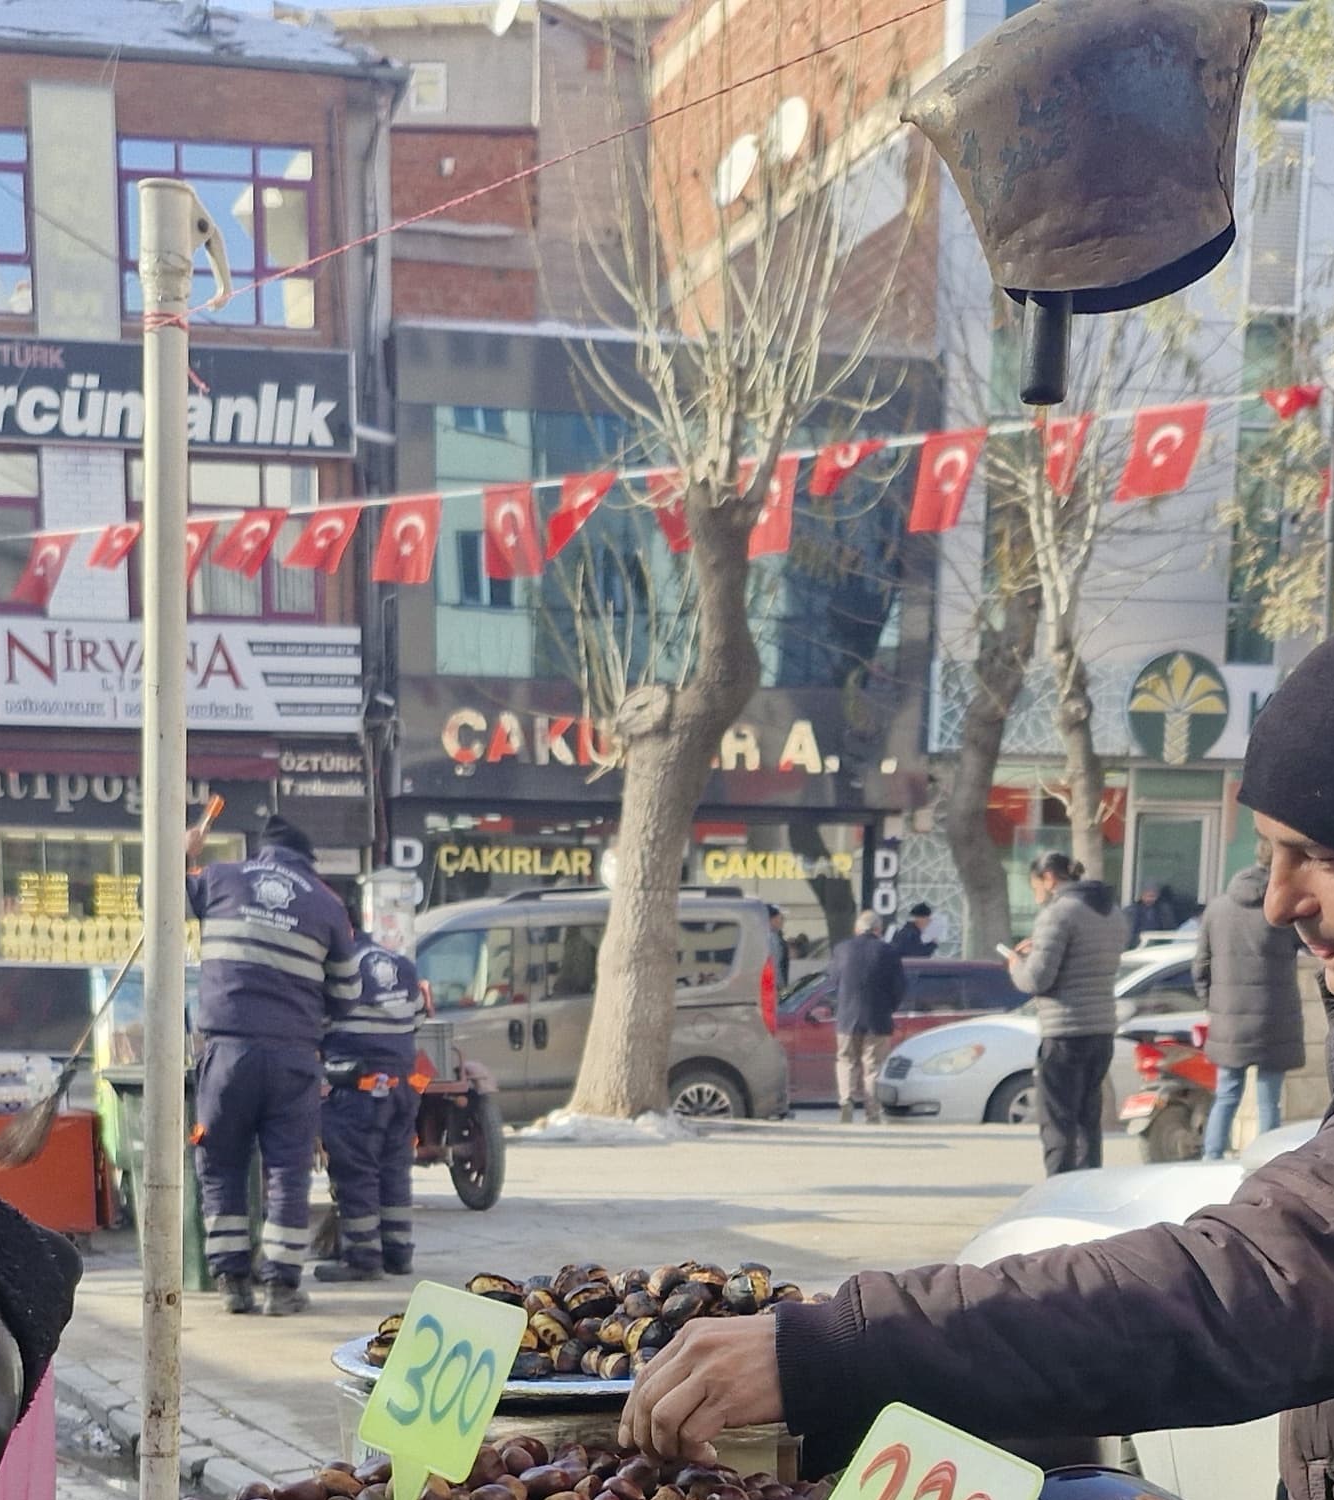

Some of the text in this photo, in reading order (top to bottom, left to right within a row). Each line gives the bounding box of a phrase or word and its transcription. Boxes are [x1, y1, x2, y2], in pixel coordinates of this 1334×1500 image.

[4, 628, 249, 690] NİRVA
[438, 845, 593, 877] ÇAKIRLAR
[385, 1313, 496, 1436] 300
